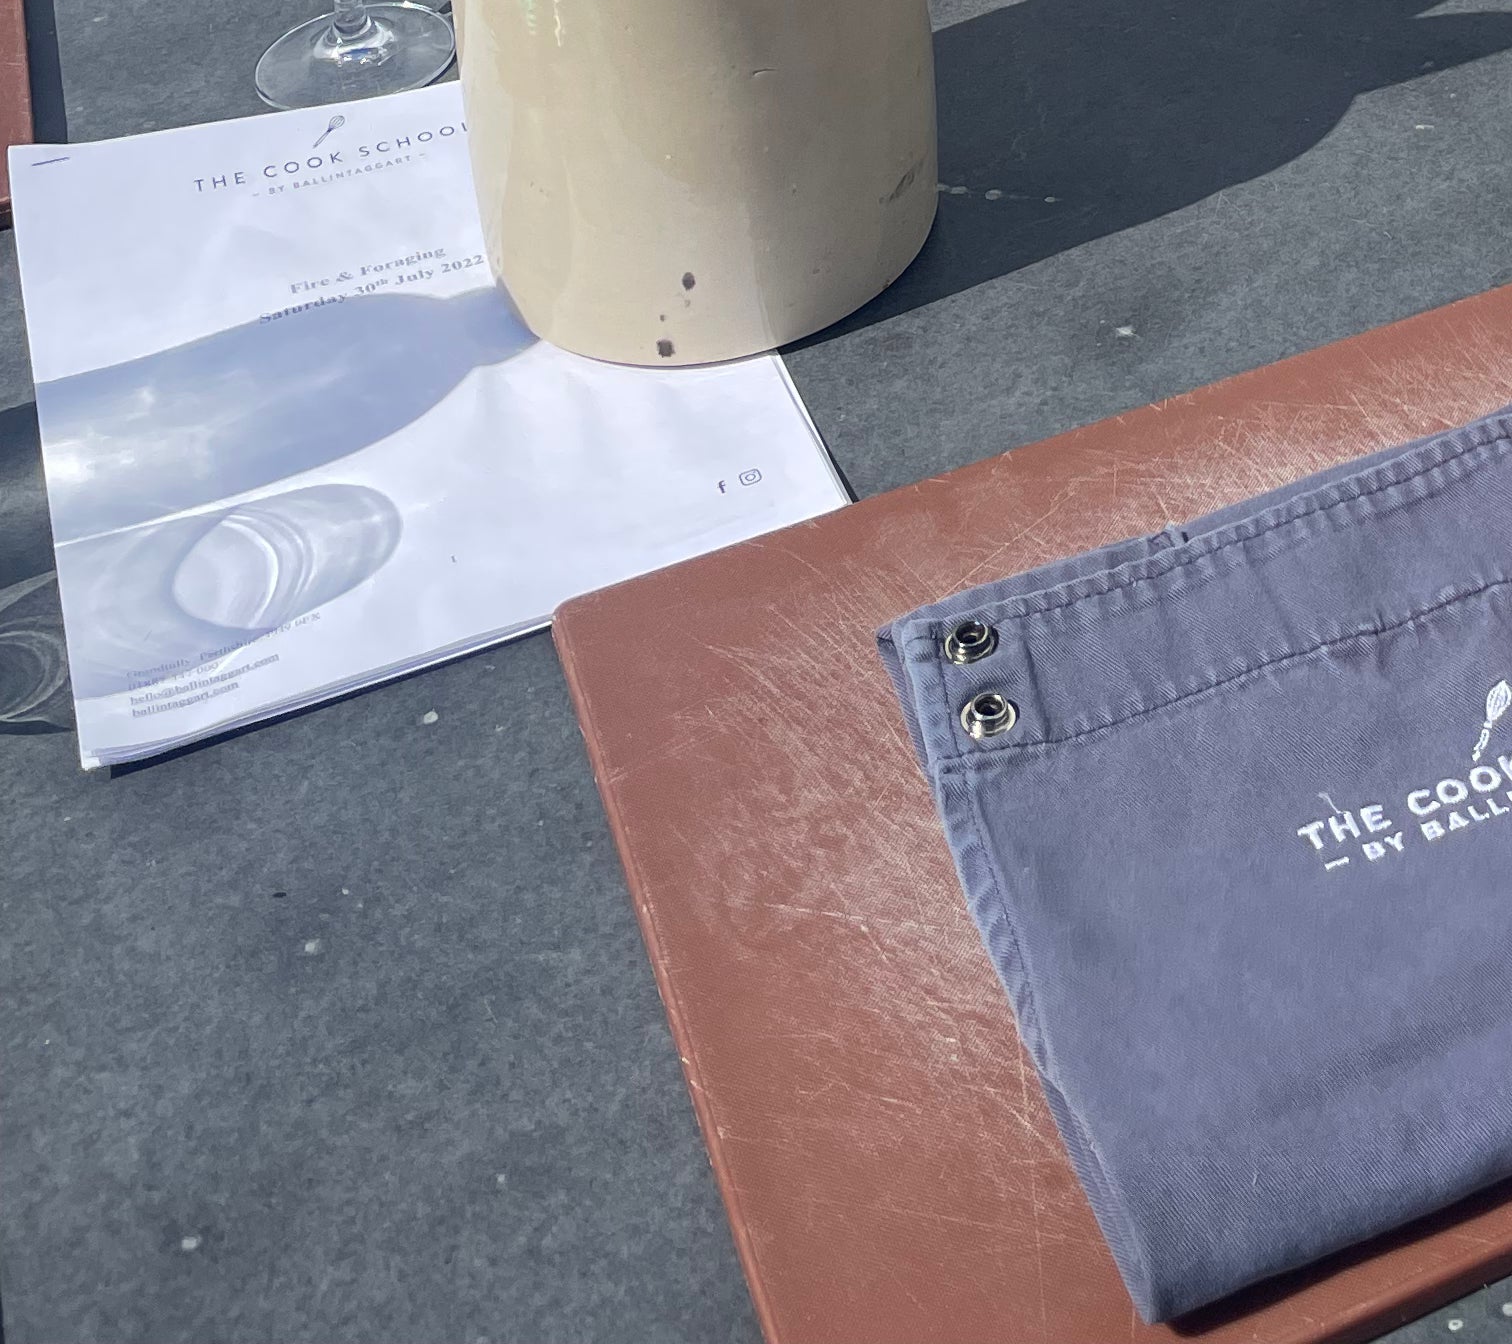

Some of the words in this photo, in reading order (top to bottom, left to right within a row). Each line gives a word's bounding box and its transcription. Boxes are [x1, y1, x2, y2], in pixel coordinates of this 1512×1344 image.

[193, 171, 247, 192] THE
[263, 151, 343, 179] COOK
[268, 184, 286, 196] BY
[292, 154, 412, 190] BALLINTAGGART
[259, 291, 348, 325] Saturday
[395, 268, 434, 286] July
[441, 253, 485, 274] 2022
[289, 277, 330, 295] Fire
[335, 271, 354, 283] &
[360, 247, 447, 276] Foraging
[1297, 802, 1393, 851] THE
[1361, 830, 1405, 862] BY
